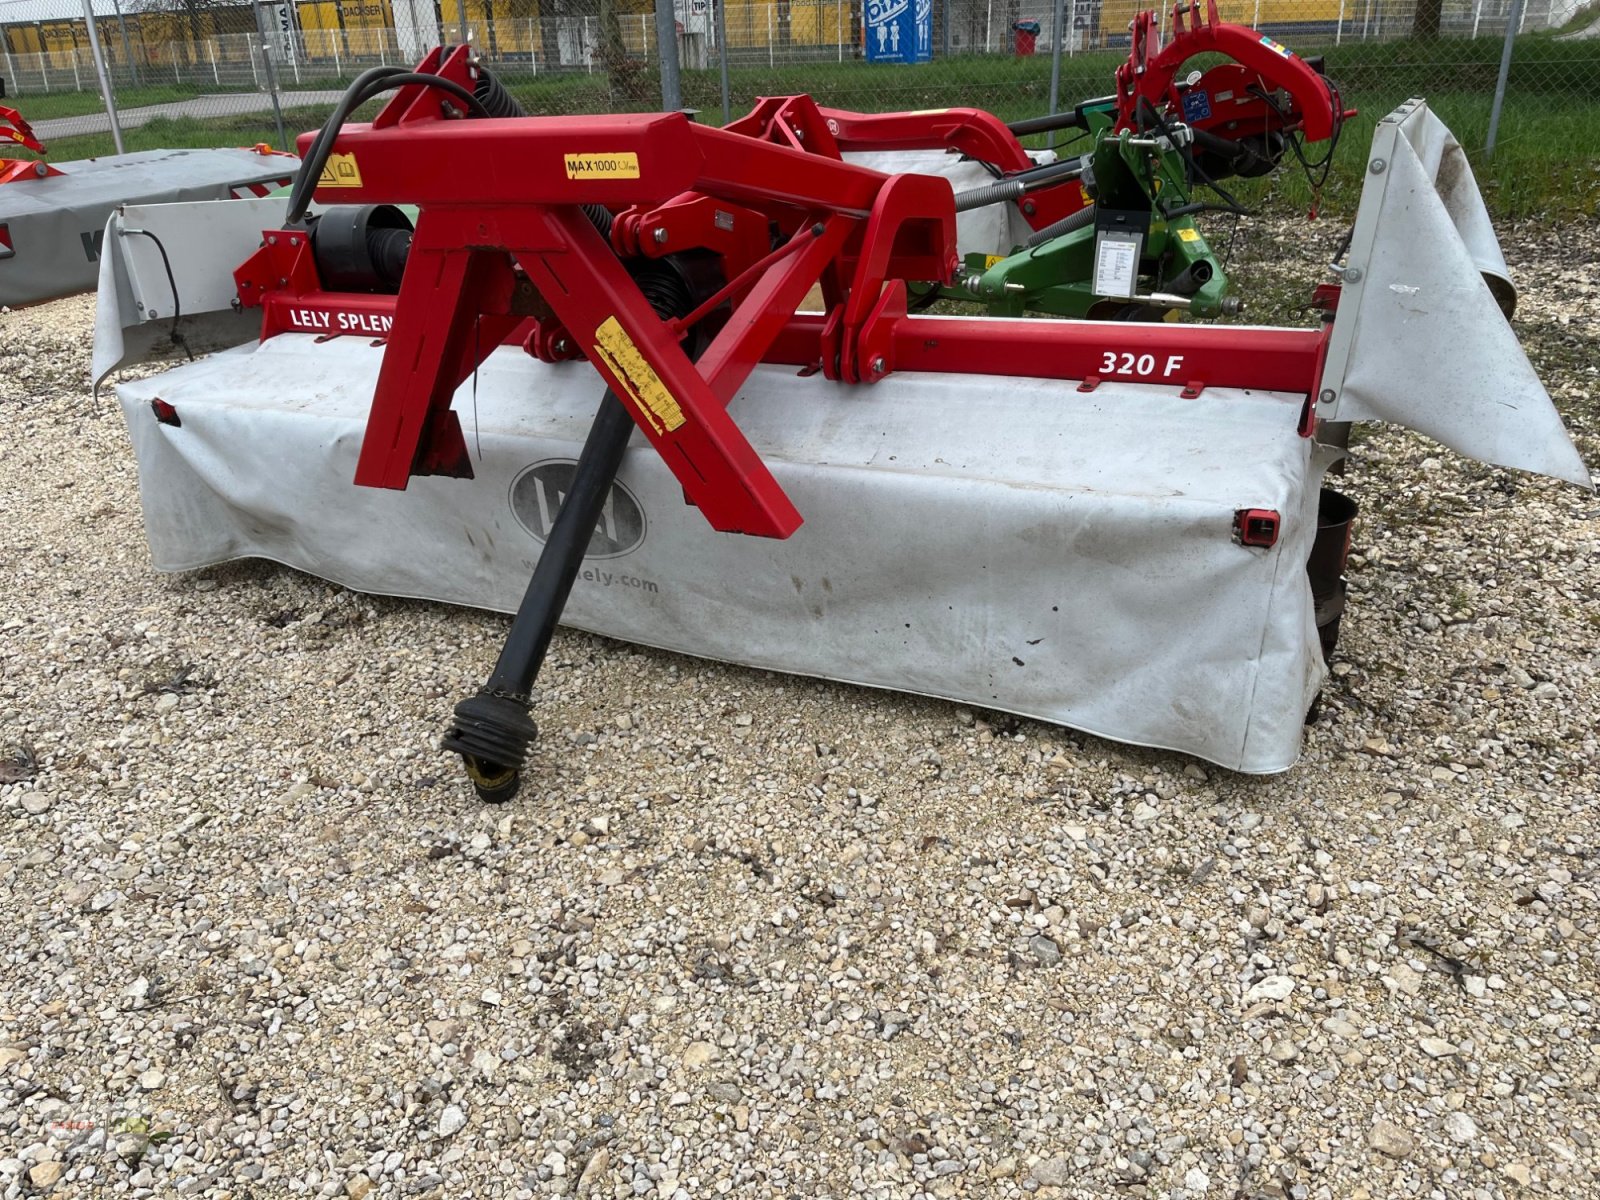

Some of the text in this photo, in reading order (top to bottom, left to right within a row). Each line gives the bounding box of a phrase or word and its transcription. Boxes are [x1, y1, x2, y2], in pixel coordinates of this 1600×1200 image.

[693, 2, 706, 11] TIP
[568, 161, 593, 172] MAX
[594, 160, 617, 171] 1000
[290, 309, 330, 328] LELY
[1099, 352, 1184, 377] 320 F
